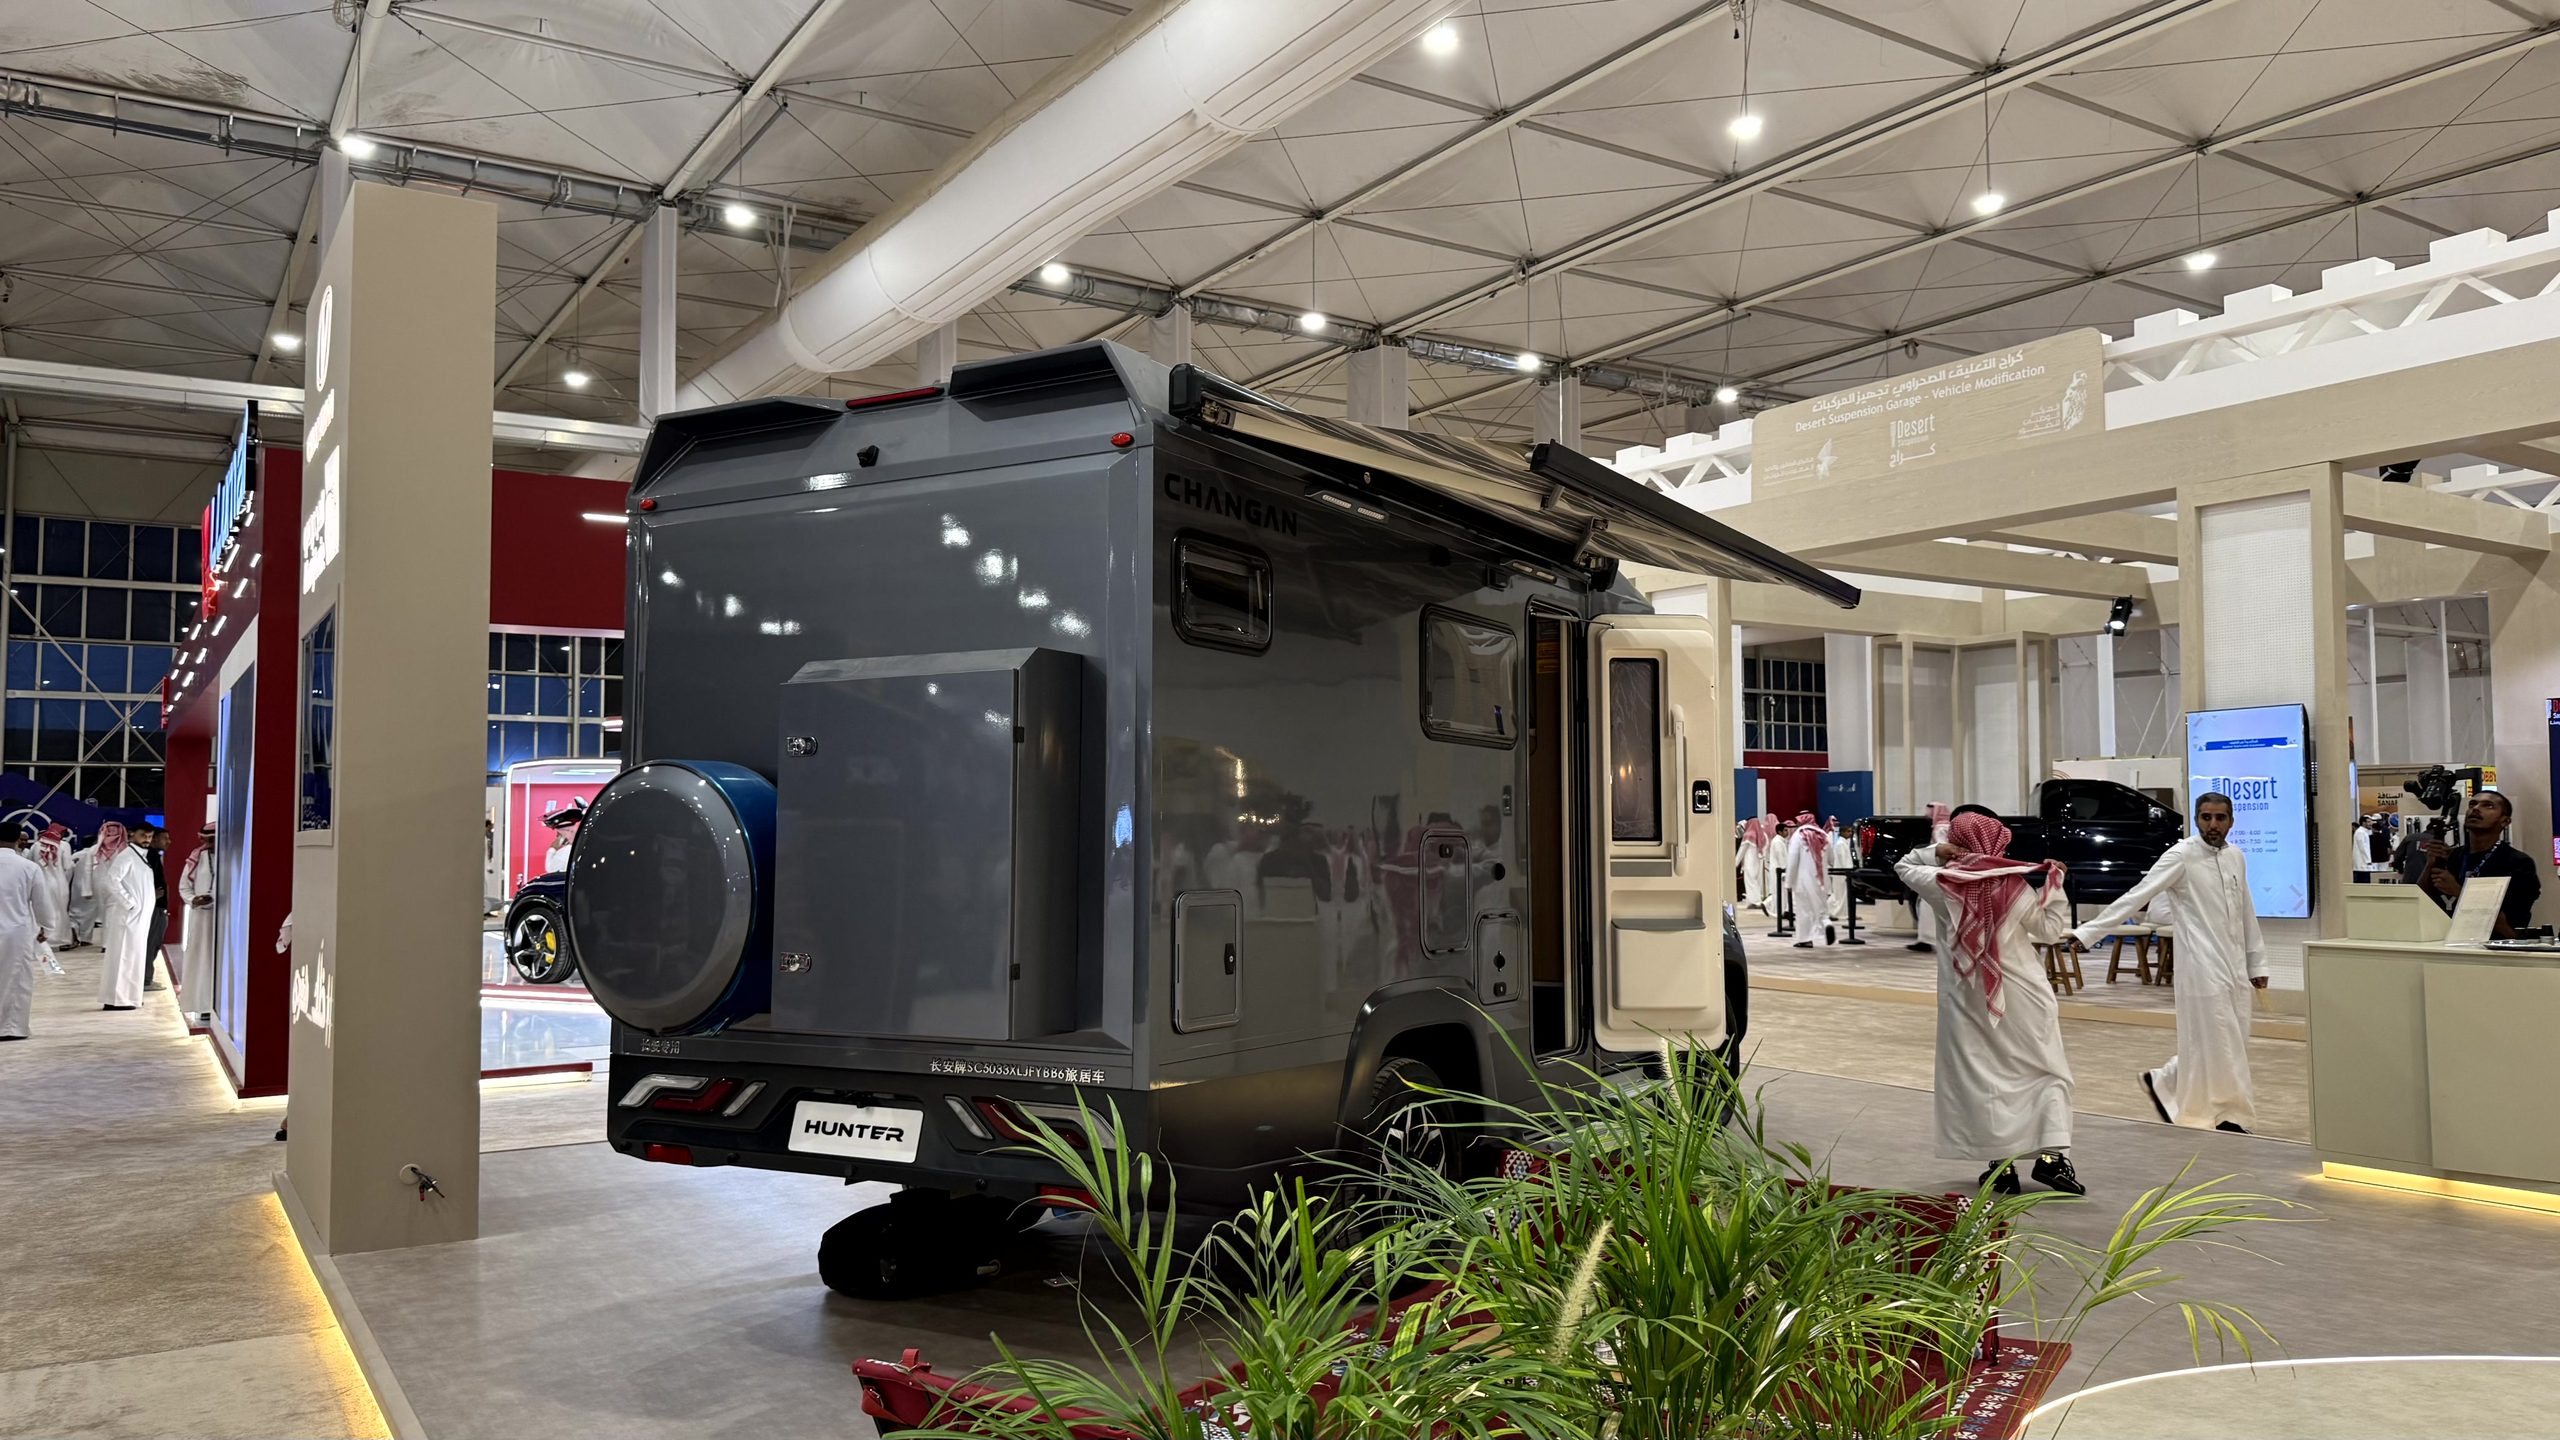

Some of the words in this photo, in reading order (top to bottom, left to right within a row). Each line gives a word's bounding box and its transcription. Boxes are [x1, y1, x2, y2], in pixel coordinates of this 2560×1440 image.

[1999, 349, 2024, 370] كراج
[1892, 370, 1946, 397] الصحراوي
[1795, 417, 1827, 433] Desert
[1829, 404, 1884, 424] Suspension
[1886, 394, 1923, 410] Garage
[1932, 382, 1972, 400] Vehicle
[1974, 365, 2045, 390] Modification
[1812, 391, 1856, 413] المركبات
[1897, 413, 1936, 439] Desert
[1889, 442, 1936, 468] كراج
[1164, 472, 1298, 537] CHANGAN
[2222, 776, 2278, 800] Desert
[2233, 801, 2269, 813] spension
[804, 1119, 905, 1142] HUNTER
